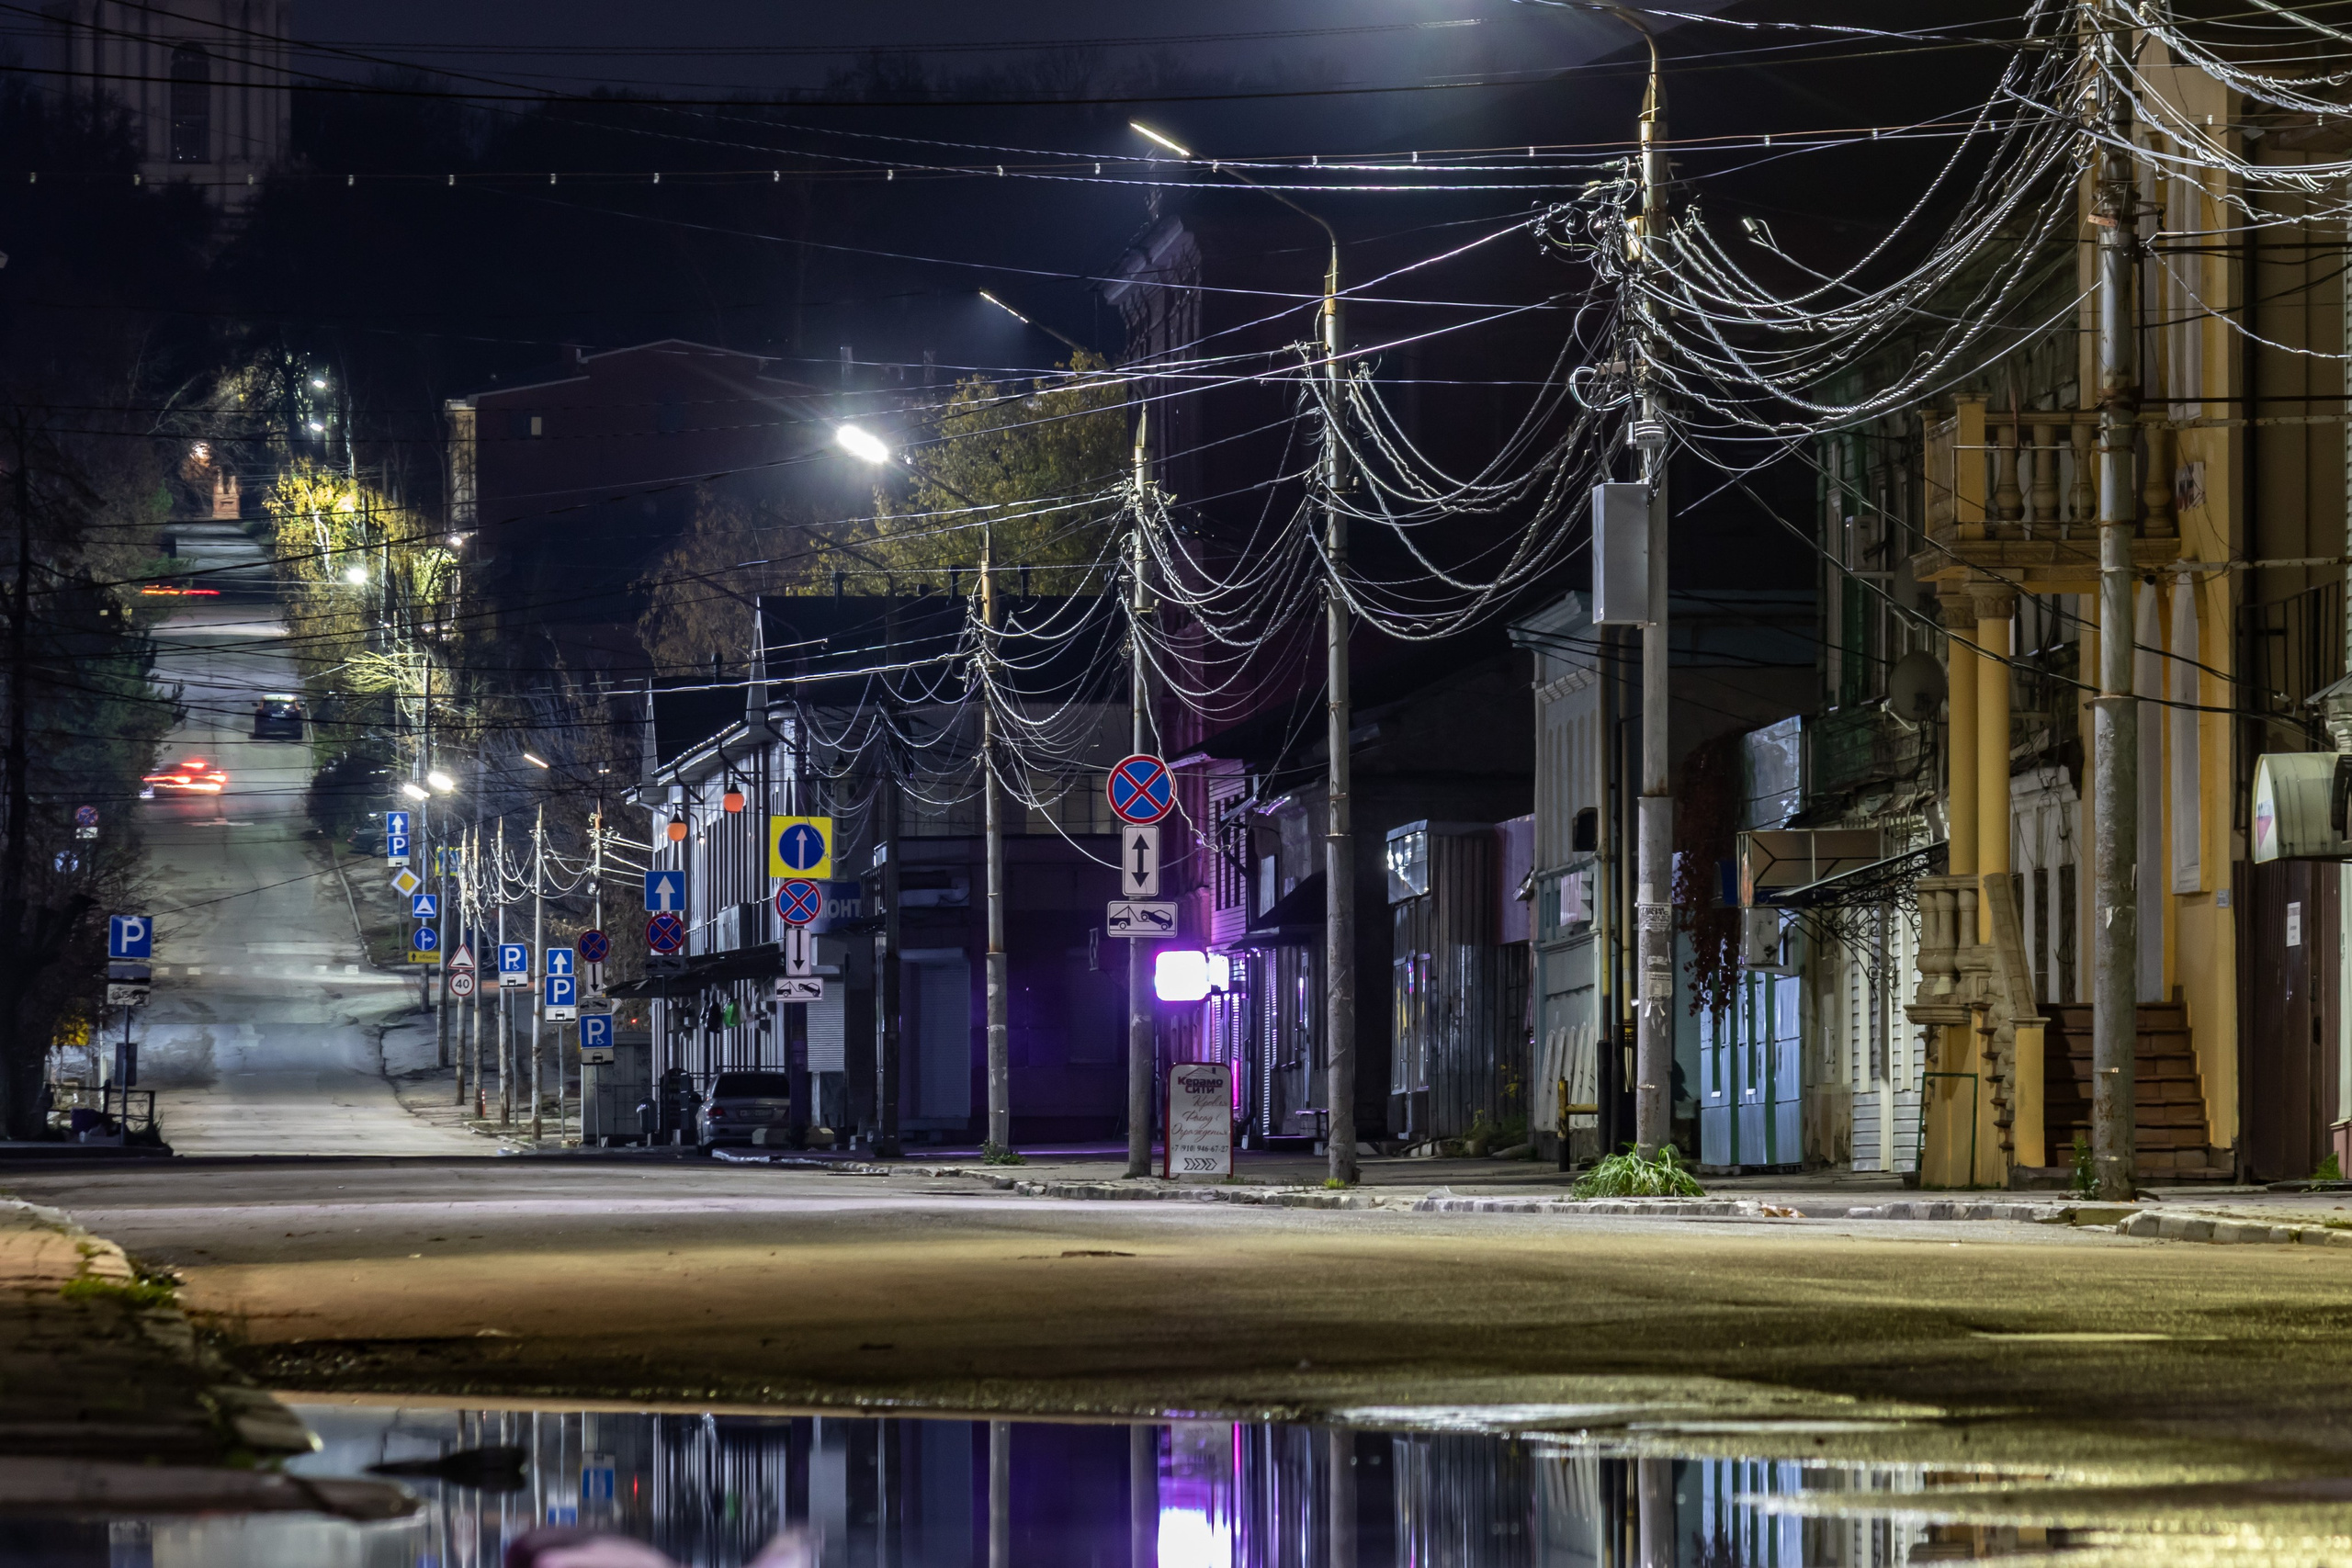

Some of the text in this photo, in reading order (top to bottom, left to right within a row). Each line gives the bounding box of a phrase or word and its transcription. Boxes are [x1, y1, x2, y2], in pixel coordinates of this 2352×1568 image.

[392, 837, 406, 855] P
[120, 919, 145, 953] P
[504, 947, 521, 970] P
[455, 978, 469, 989] 40
[553, 979, 571, 1003] P
[587, 1019, 605, 1044] P
[1177, 1076, 1224, 1087] Керамо
[1181, 1145, 1196, 1153] (910)
[1197, 1145, 1229, 1153] 946-67-27
